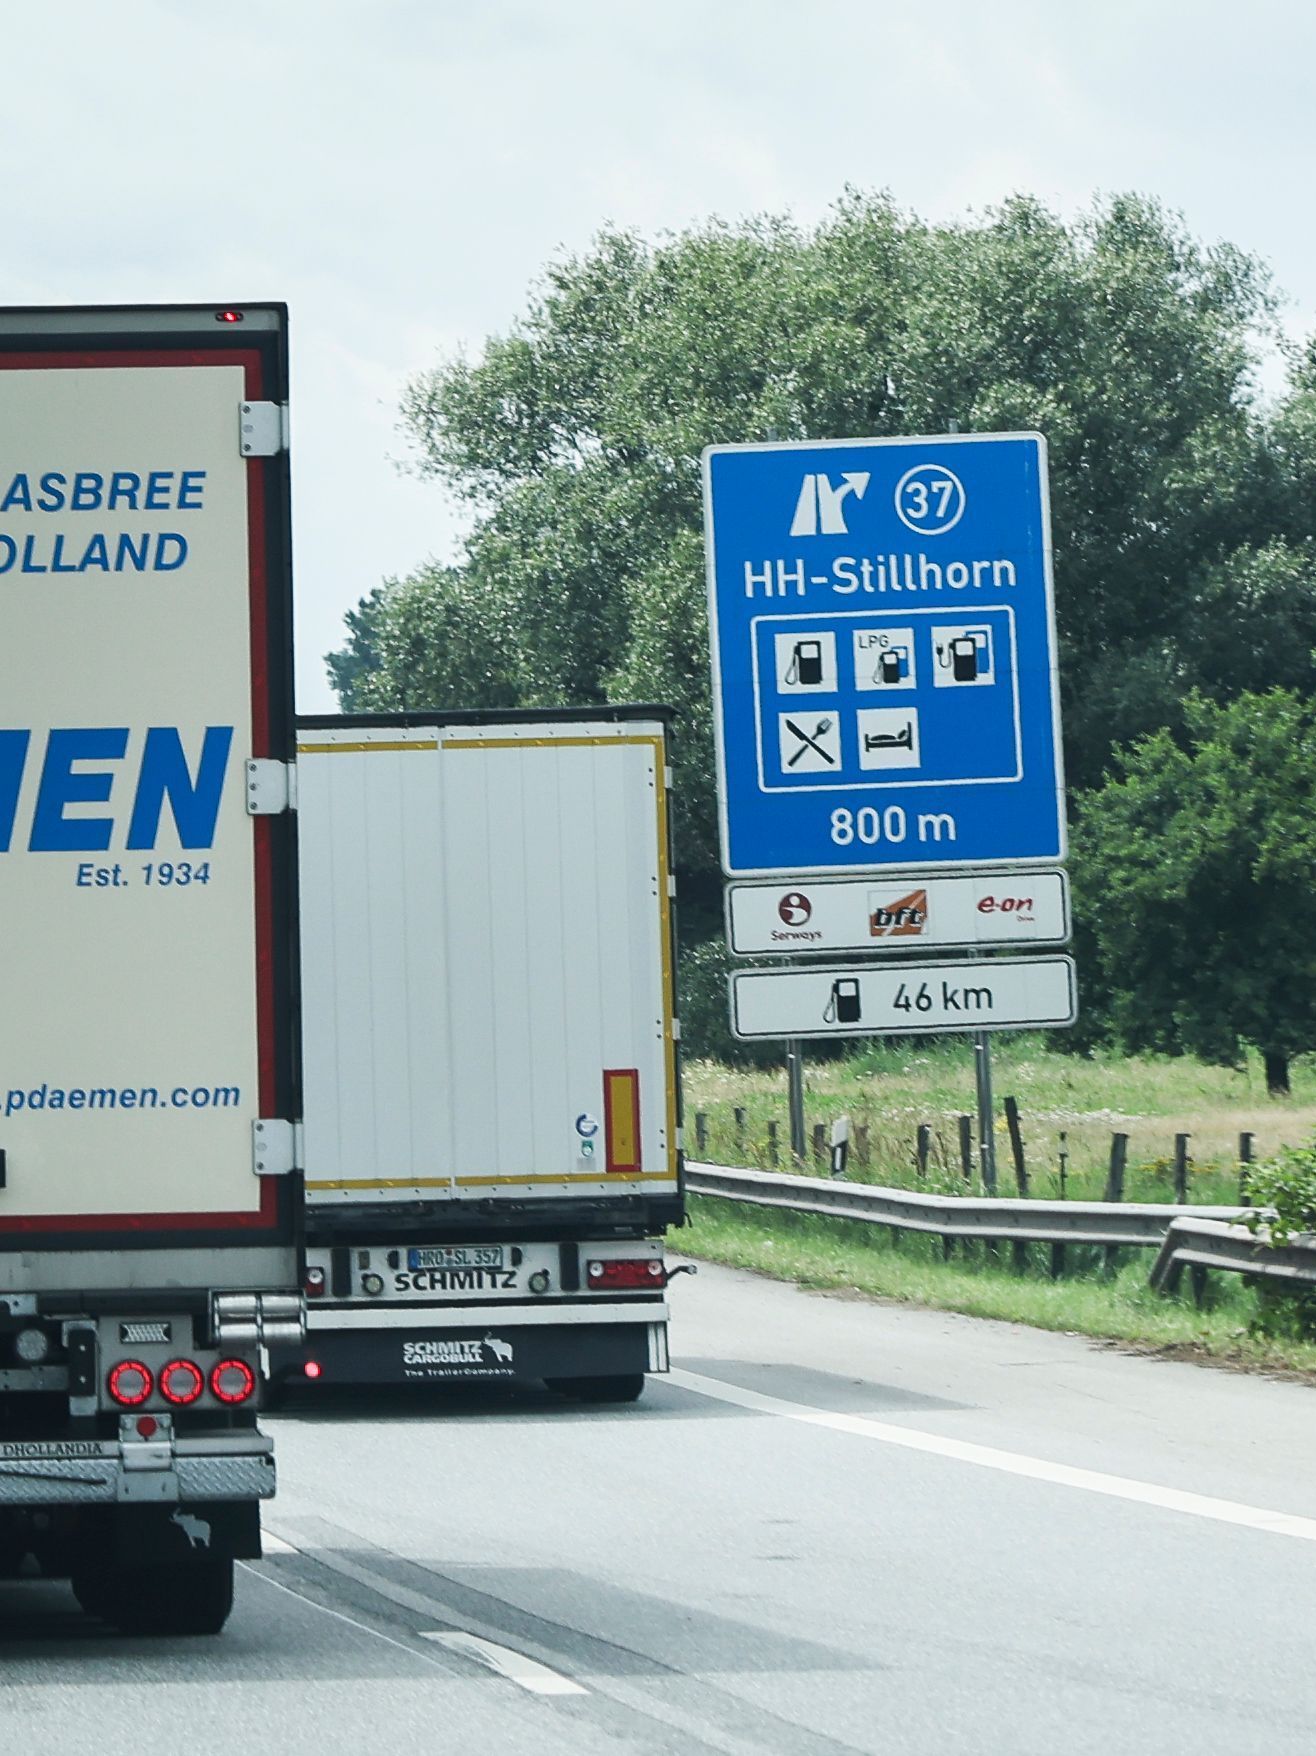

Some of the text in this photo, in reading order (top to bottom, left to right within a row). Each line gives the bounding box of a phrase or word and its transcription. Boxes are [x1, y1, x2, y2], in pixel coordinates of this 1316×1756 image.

[905, 480, 953, 519] 37
[743, 553, 1017, 598] HH-Stillhorn
[858, 634, 890, 649] LPG
[830, 805, 957, 846] 800 m
[76, 862, 211, 887] Est. 1934
[873, 907, 925, 928] bft
[770, 929, 823, 942] Serways
[893, 981, 993, 1013] 46 km
[454, 1249, 471, 1265] SL
[475, 1248, 499, 1264] 357
[394, 1270, 518, 1292] SCHMITZ
[403, 1341, 482, 1355] SCHMITZ
[403, 1353, 484, 1364] CARGOBULL
[3, 1443, 102, 1457] DHOLLANDIA
